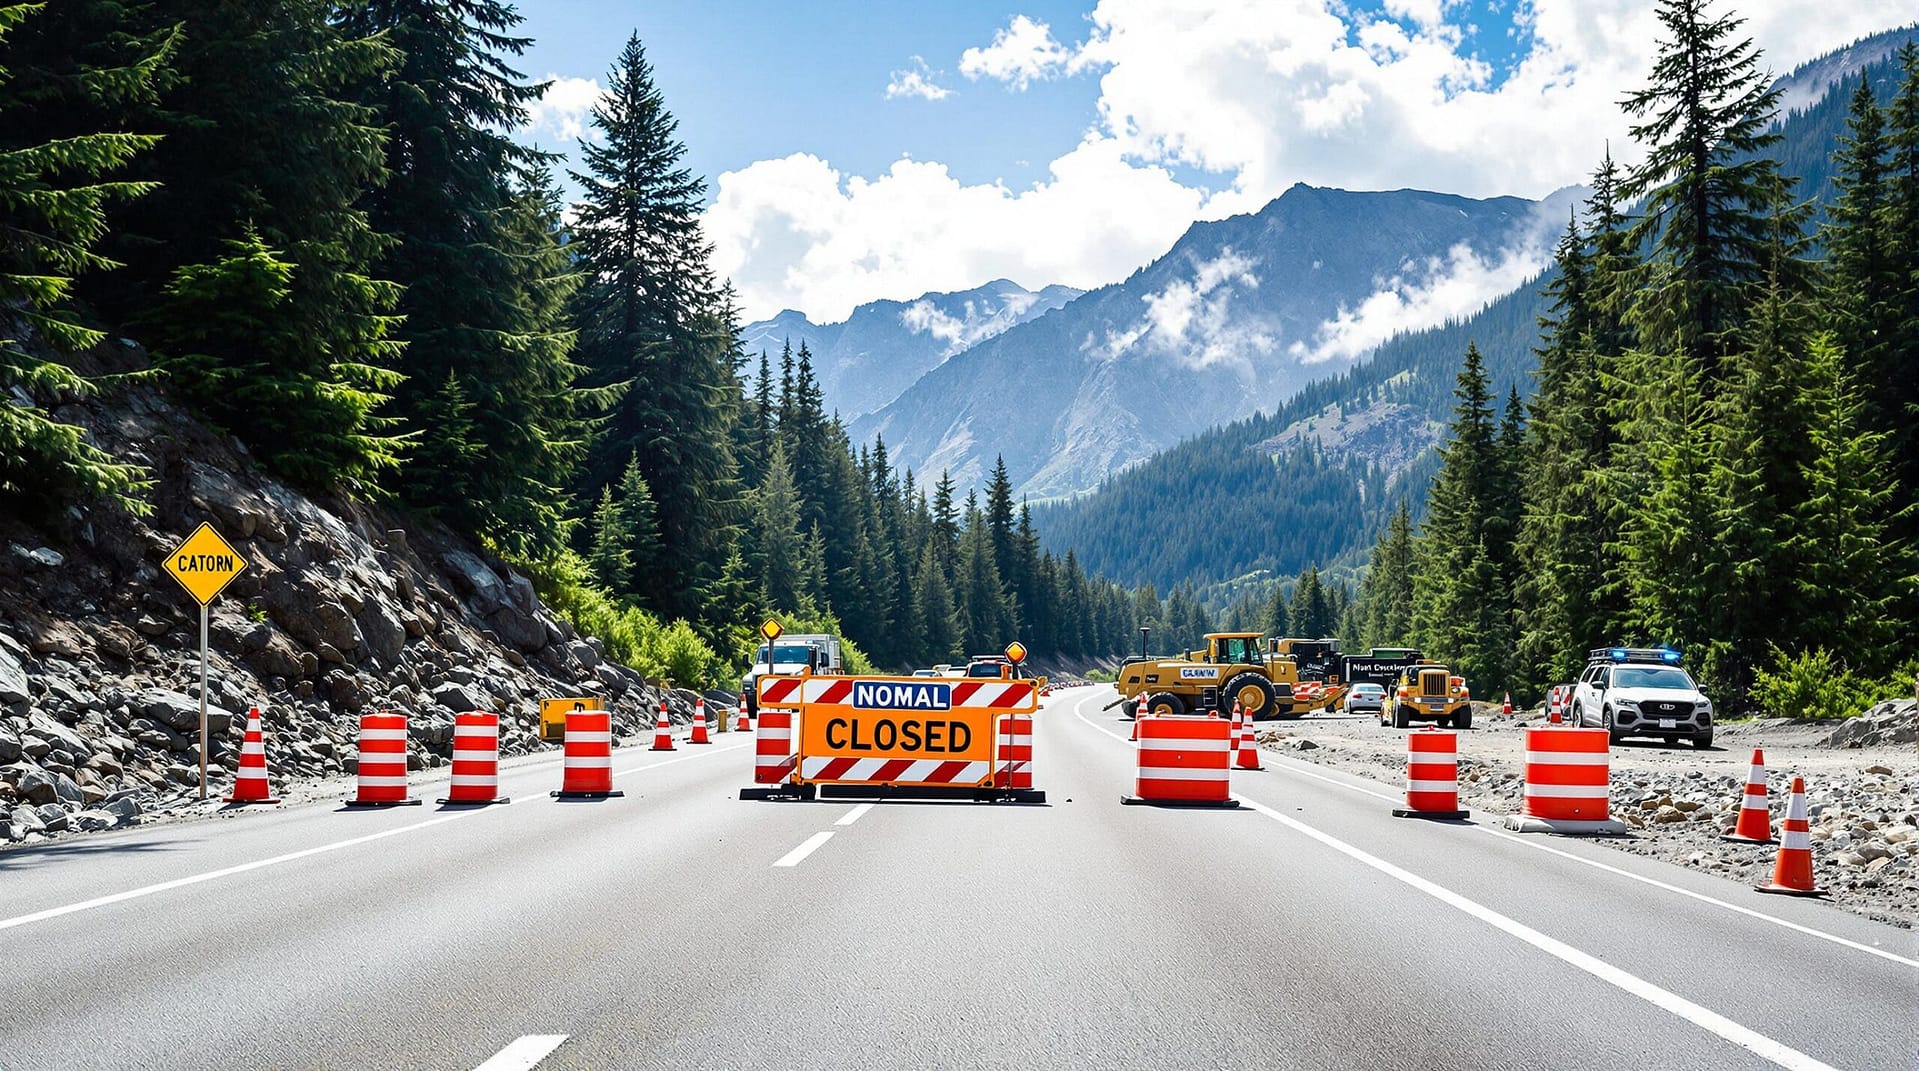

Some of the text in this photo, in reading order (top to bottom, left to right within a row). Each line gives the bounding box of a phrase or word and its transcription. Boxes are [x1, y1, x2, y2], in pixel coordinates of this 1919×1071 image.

[178, 555, 233, 572] CATORN
[857, 685, 947, 708] NOMAL
[826, 718, 971, 753] CLOSED
